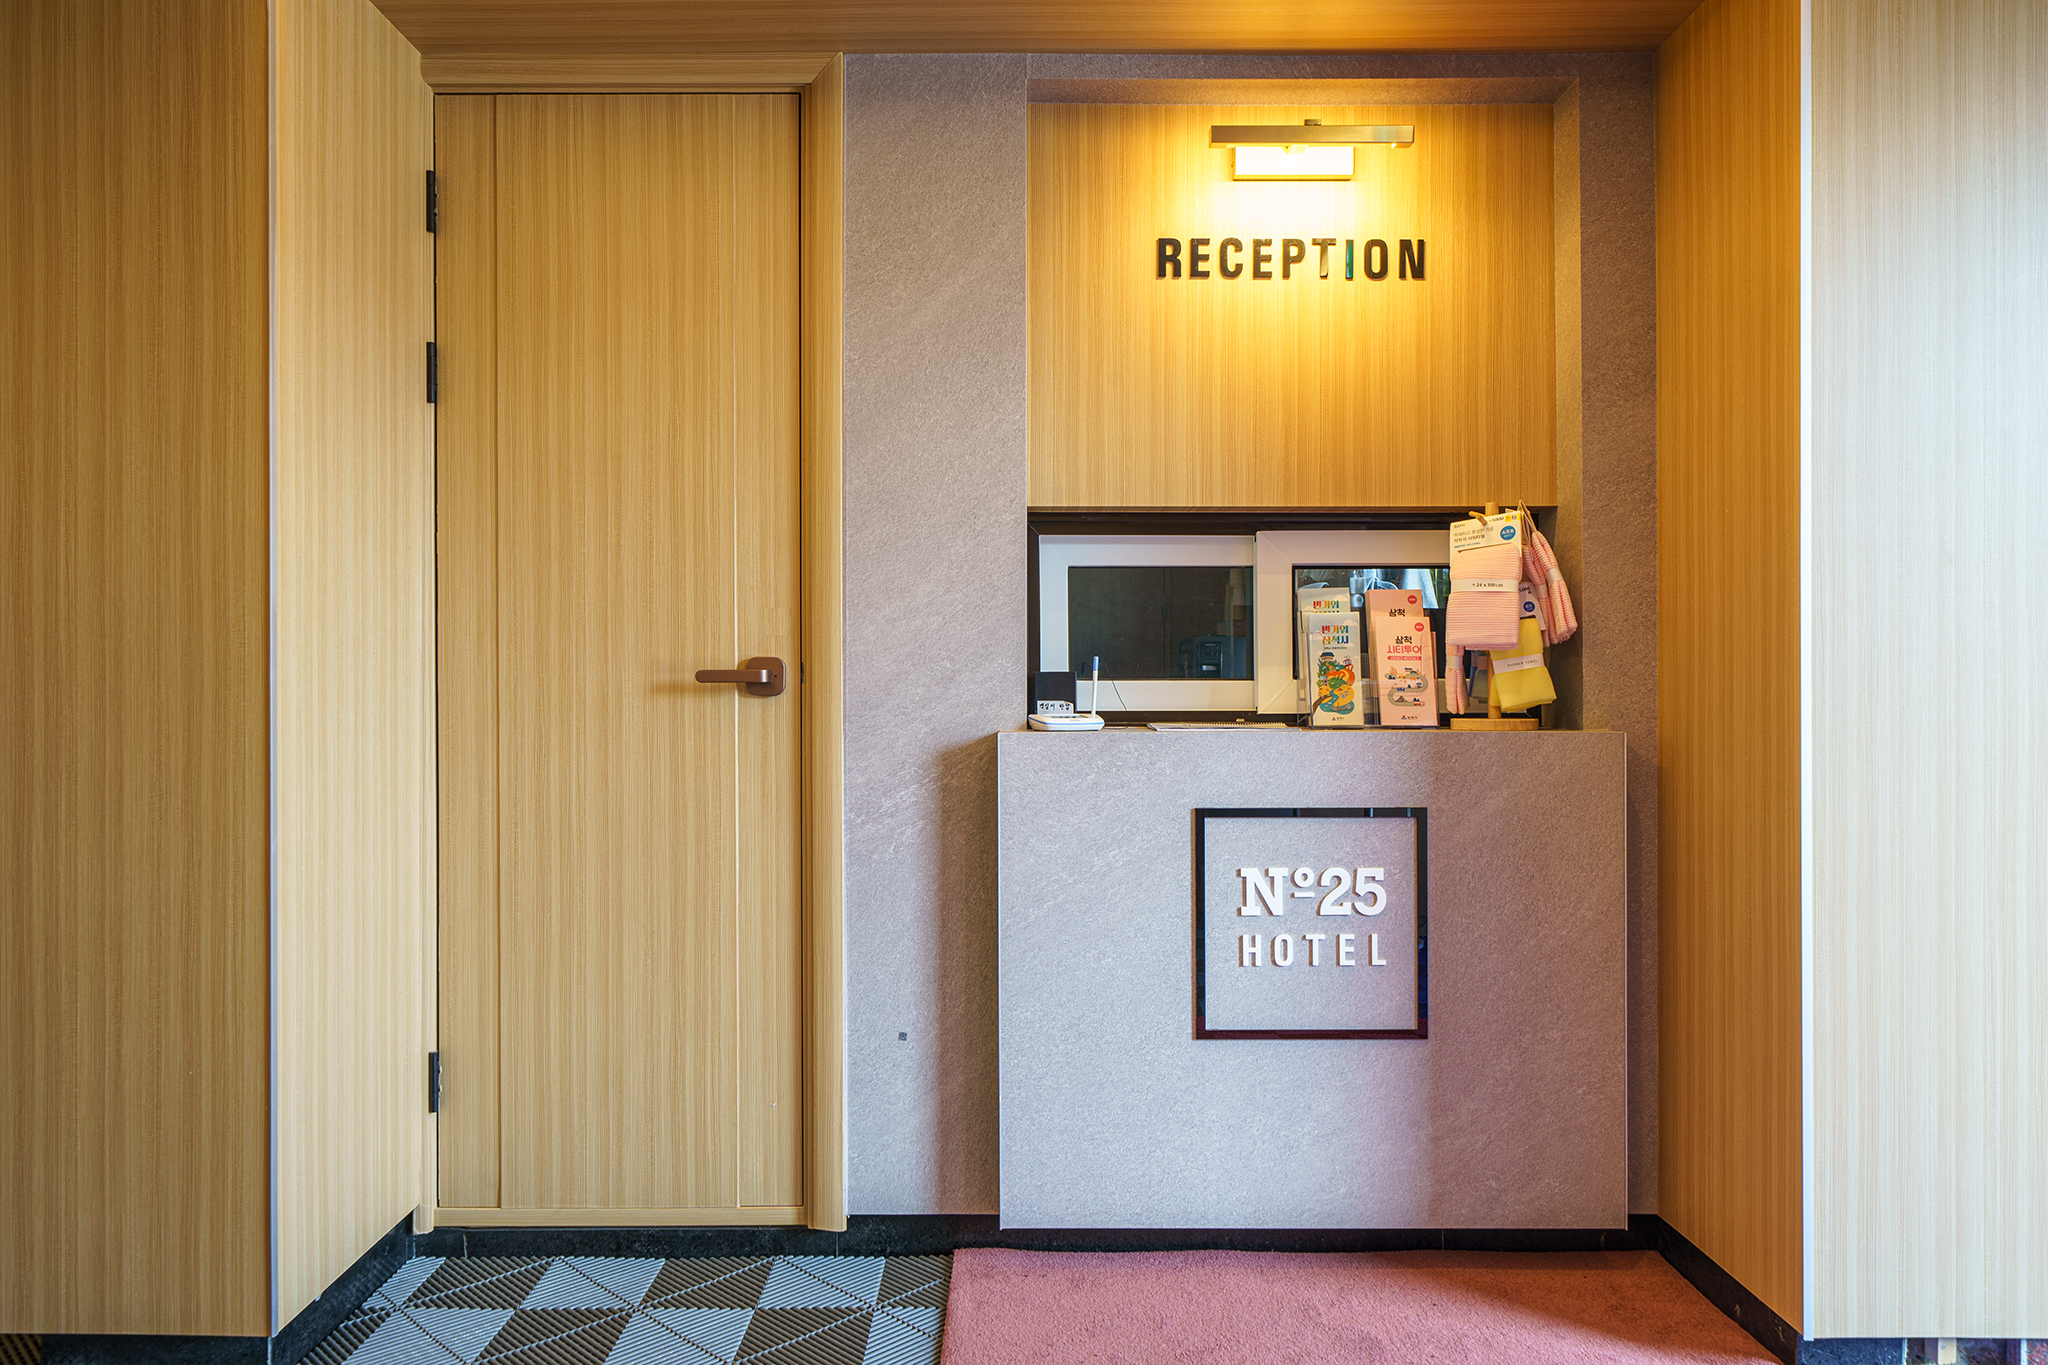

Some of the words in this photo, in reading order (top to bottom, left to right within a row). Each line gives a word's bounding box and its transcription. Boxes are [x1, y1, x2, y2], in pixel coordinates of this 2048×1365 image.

[1156, 237, 1425, 280] RECEPTION
[1389, 608, 1405, 617] 삼척
[1395, 636, 1412, 644] 삼척
[1387, 645, 1422, 654] 시티투어
[1239, 933, 1387, 967] HOTEL
